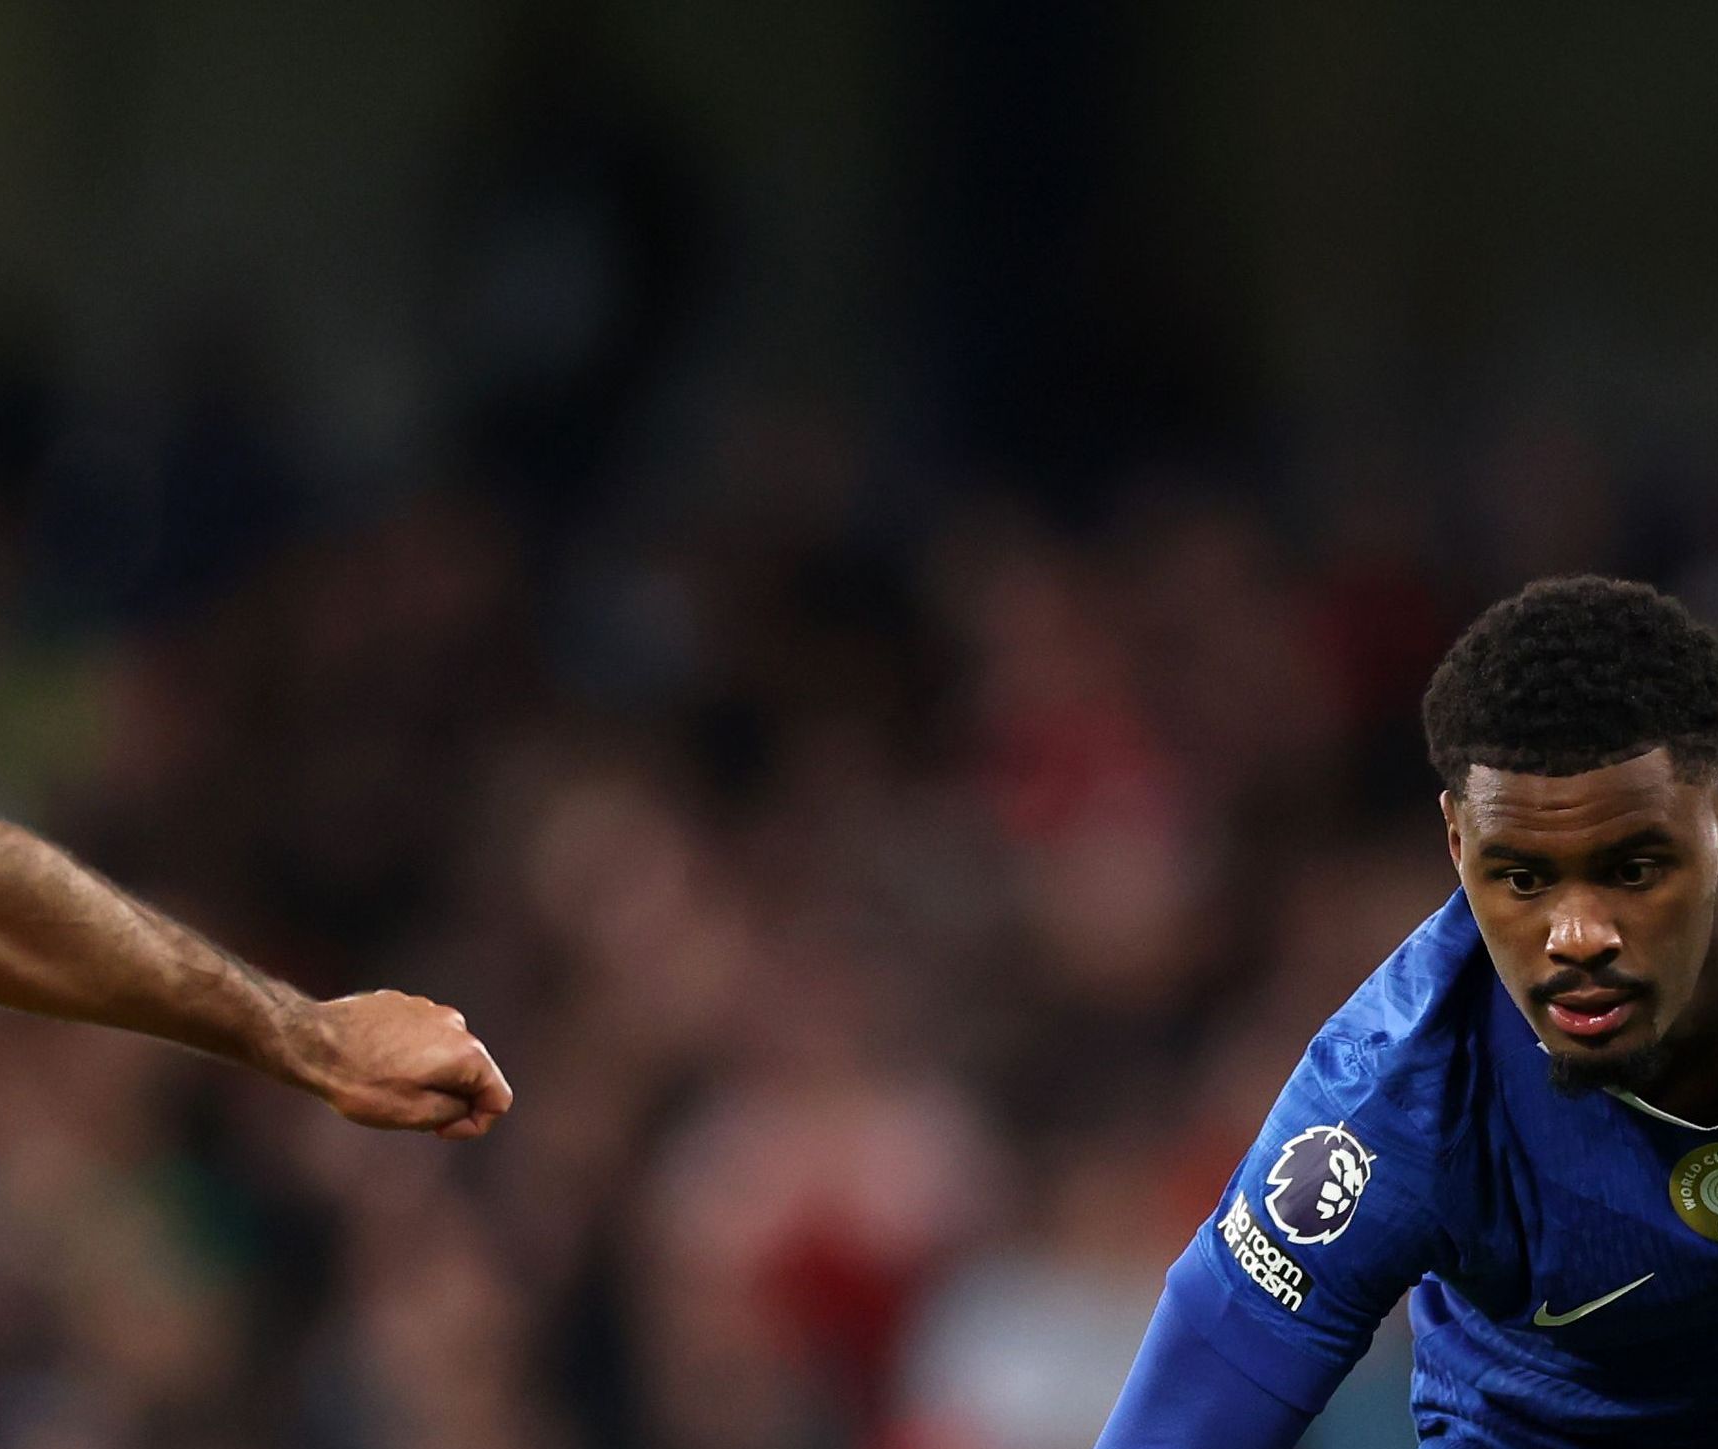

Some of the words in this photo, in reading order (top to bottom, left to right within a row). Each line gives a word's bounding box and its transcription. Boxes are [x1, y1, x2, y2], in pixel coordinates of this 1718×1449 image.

[1680, 1163, 1702, 1211] WORLD
[1229, 1190, 1251, 1233] No
[1245, 1225, 1303, 1287] room
[1234, 1241, 1303, 1312] racism
